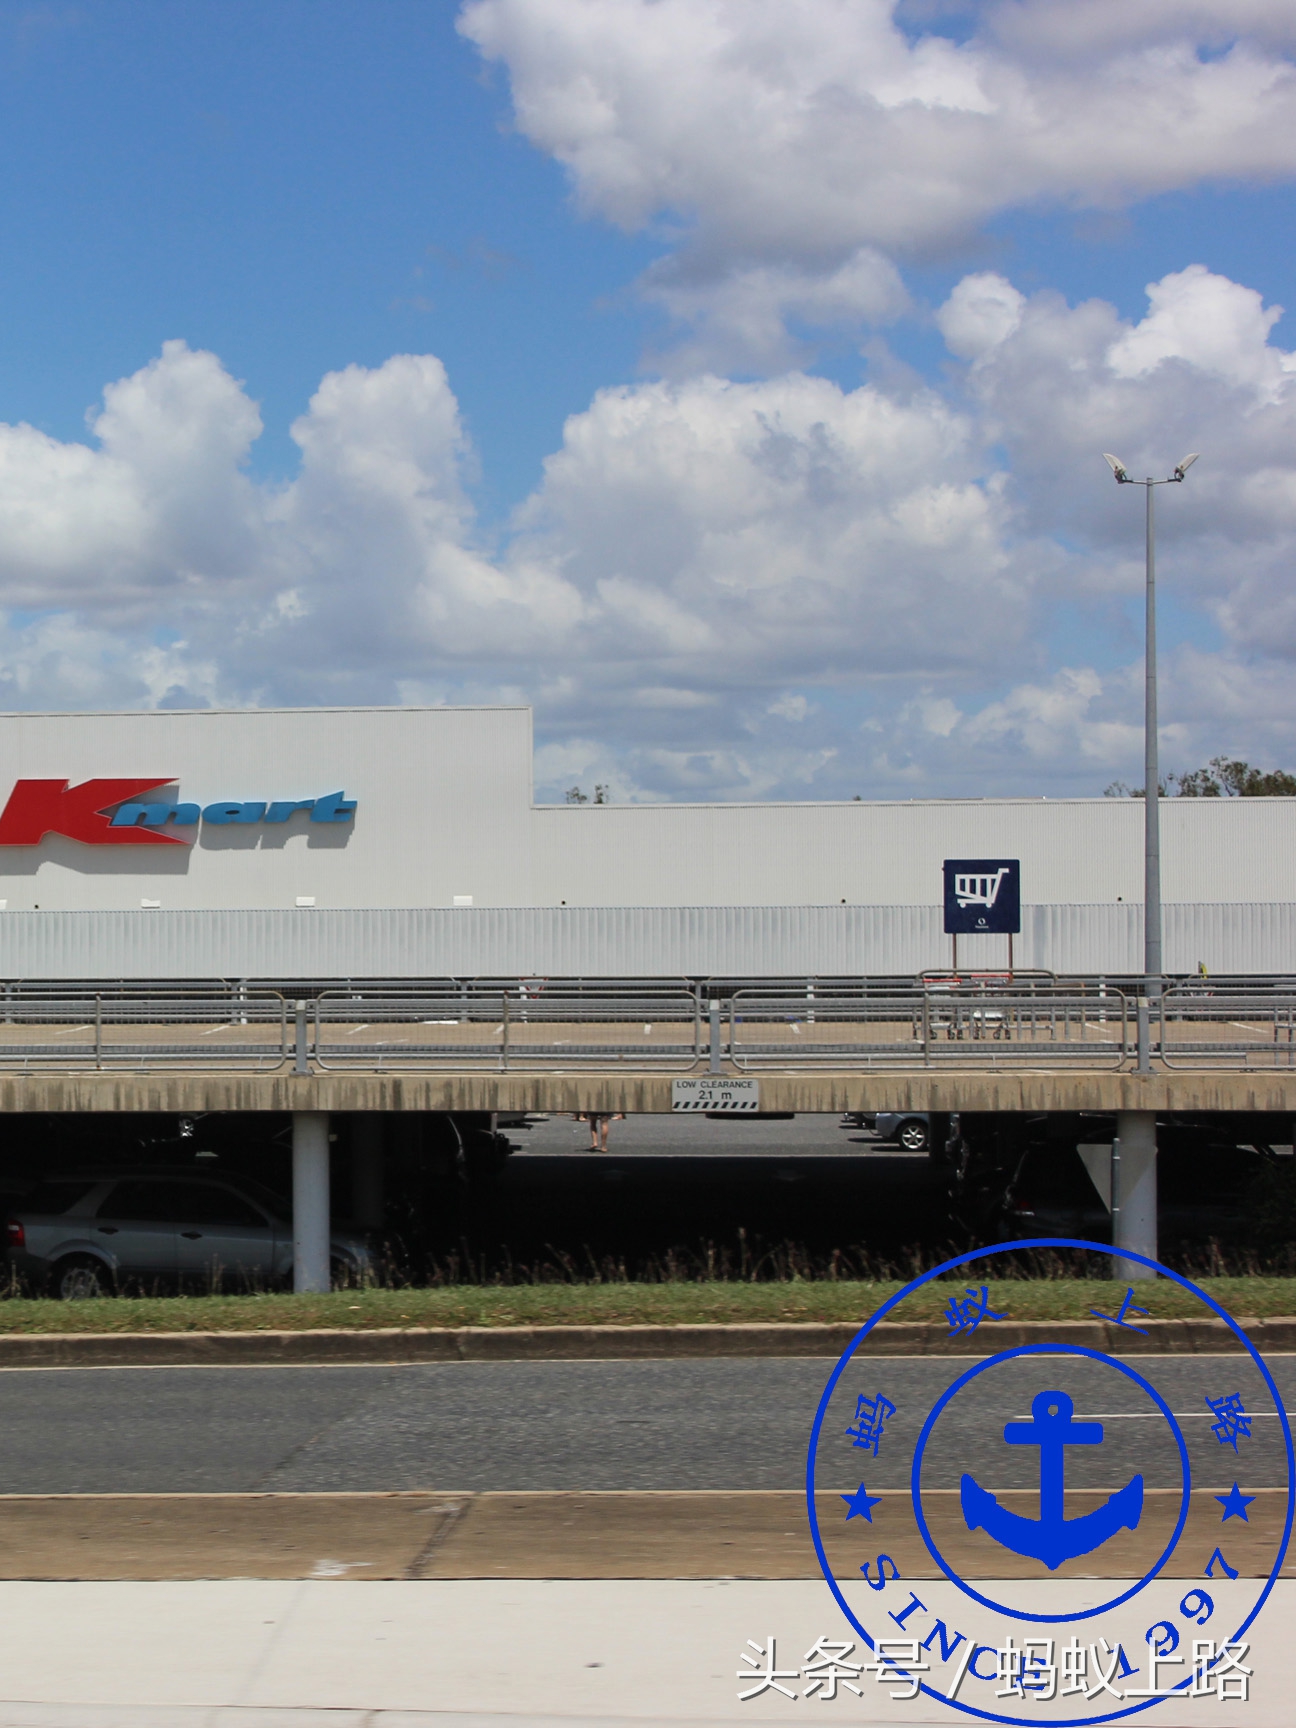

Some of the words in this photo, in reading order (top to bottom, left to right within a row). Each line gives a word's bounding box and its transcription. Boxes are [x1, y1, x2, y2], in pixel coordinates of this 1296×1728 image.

[676, 1081, 696, 1089] LOW
[700, 1081, 753, 1089] CLEARANCE
[698, 1090, 713, 1100] 2.1
[721, 1091, 732, 1100] m
